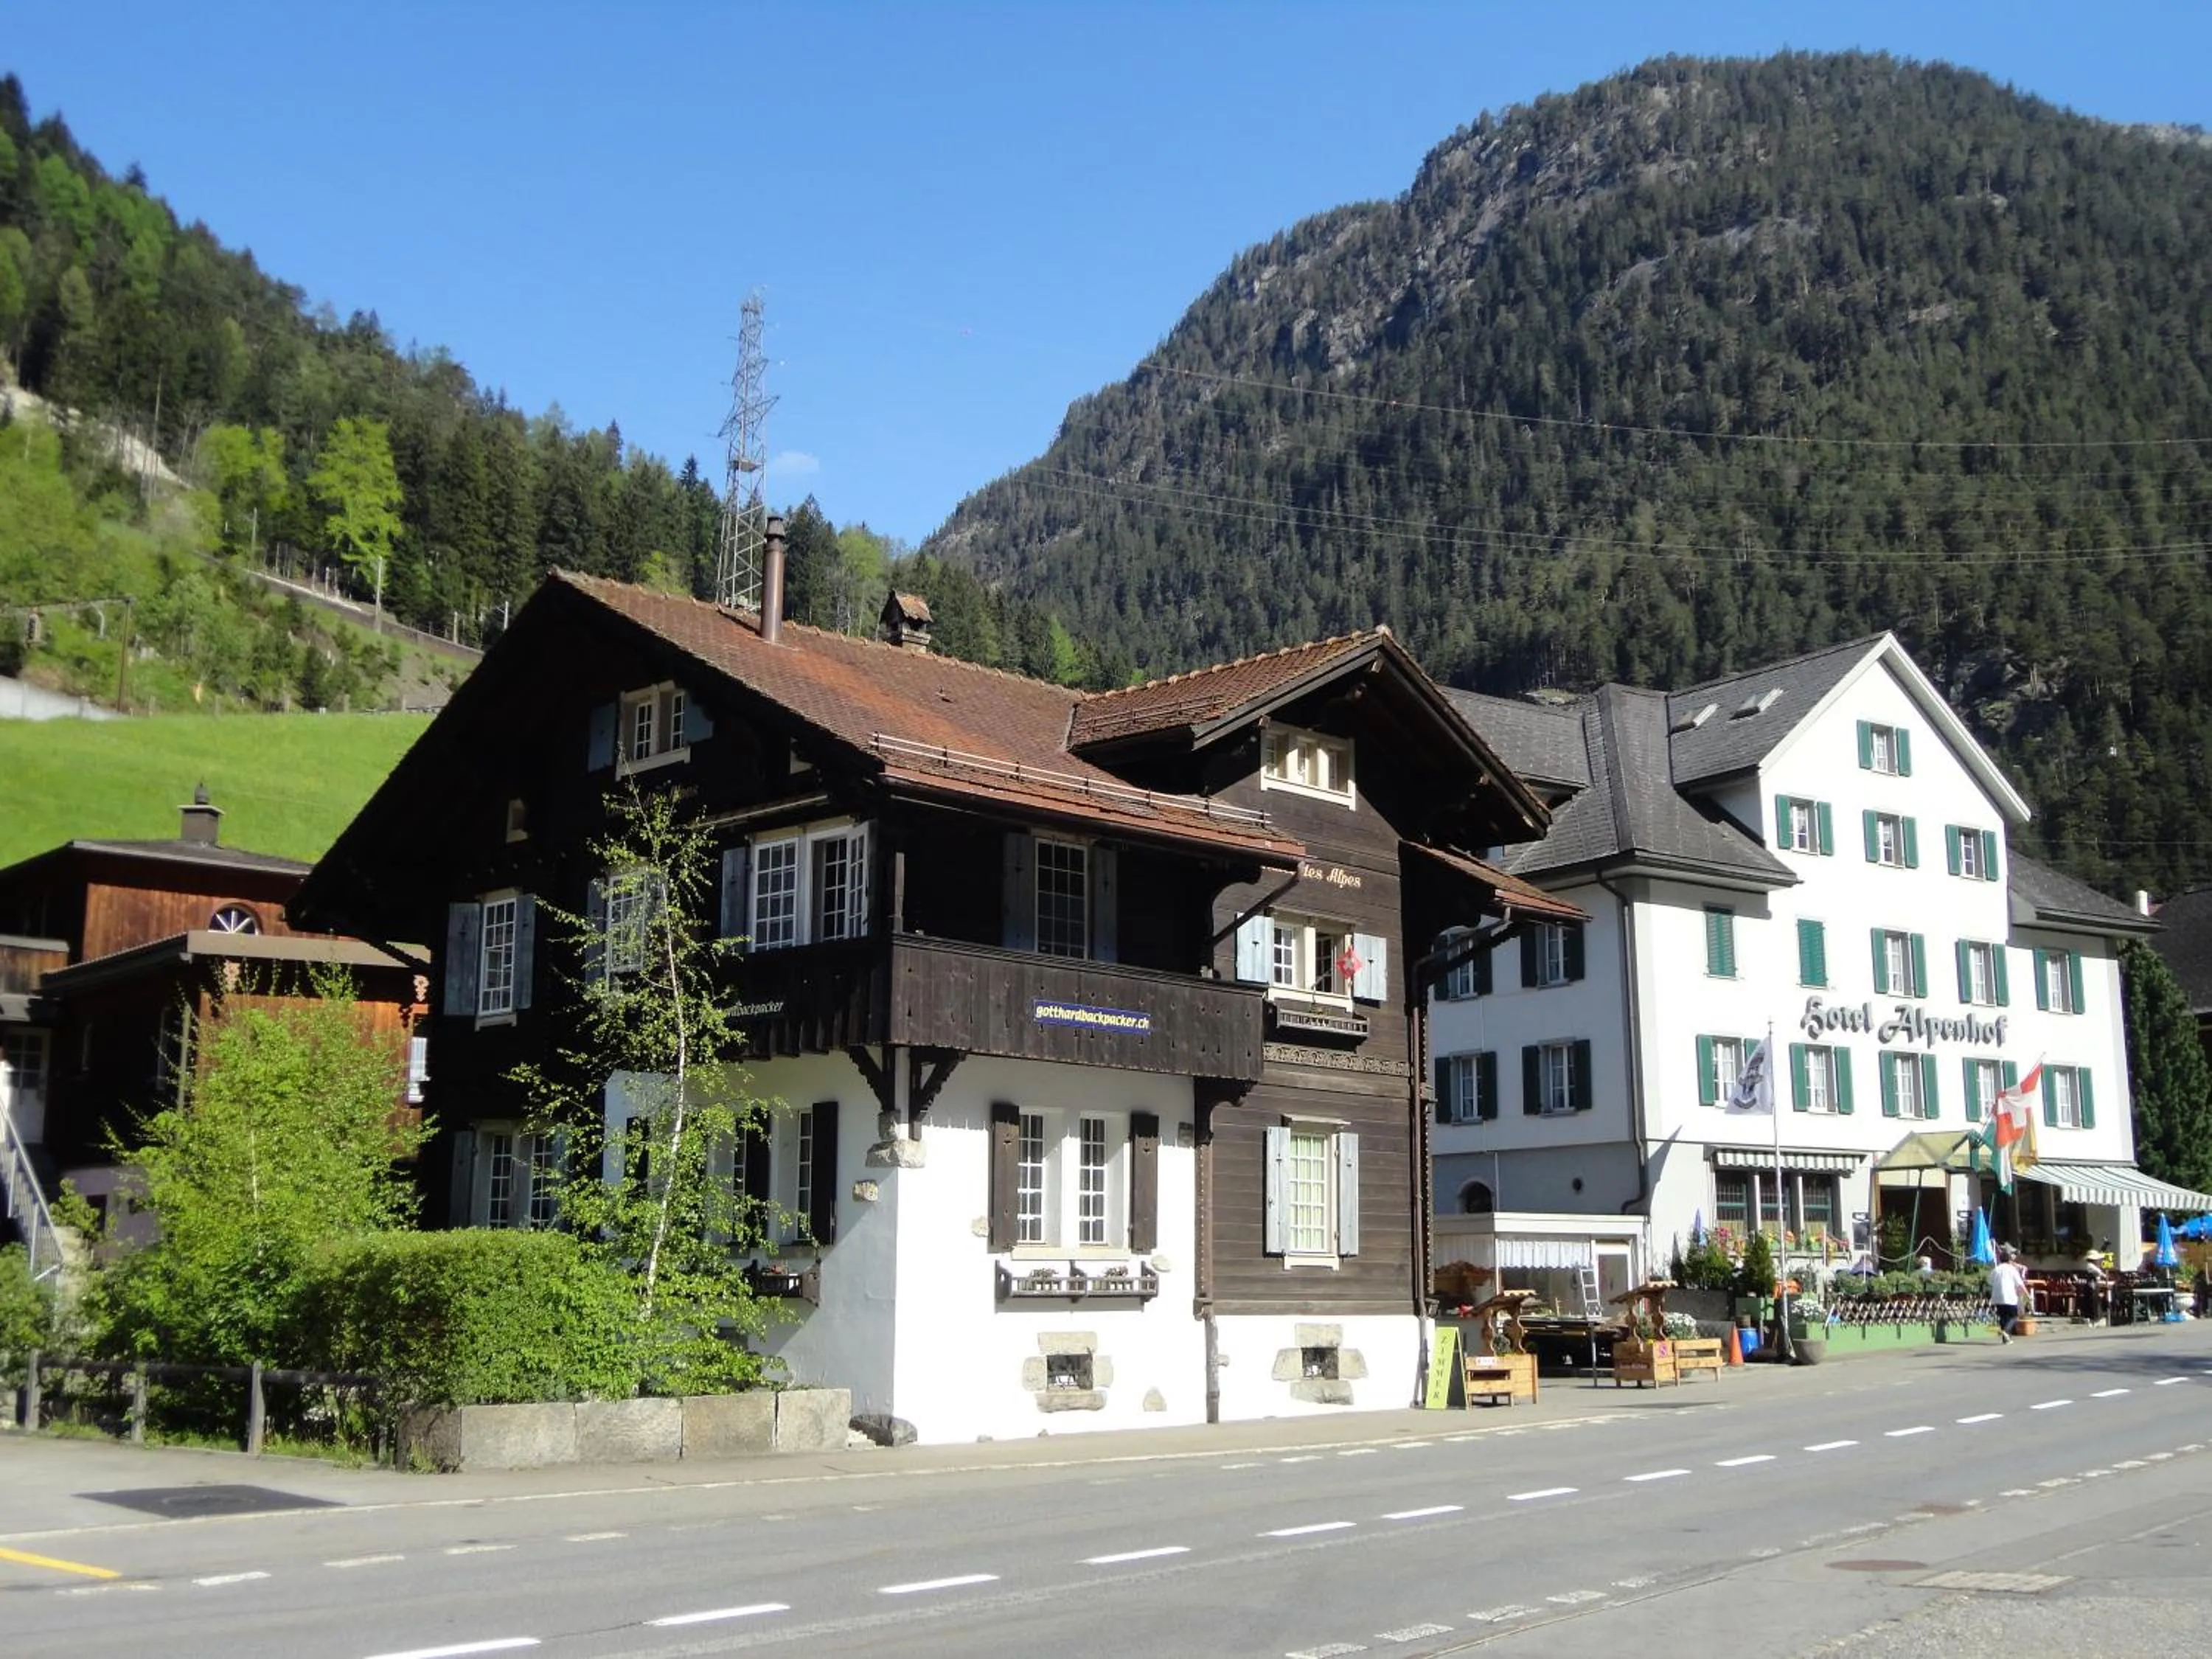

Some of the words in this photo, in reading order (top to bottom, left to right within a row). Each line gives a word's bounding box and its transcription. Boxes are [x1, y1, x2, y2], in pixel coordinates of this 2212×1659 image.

[1326, 867, 1361, 888] Alpes
[1036, 1005, 1150, 1029] gotthardbackpacker.ch
[1800, 995, 1873, 1040] Hotel
[1878, 1004, 2008, 1049] Alpenhof
[1433, 1333, 1450, 1399] ZIMMER
